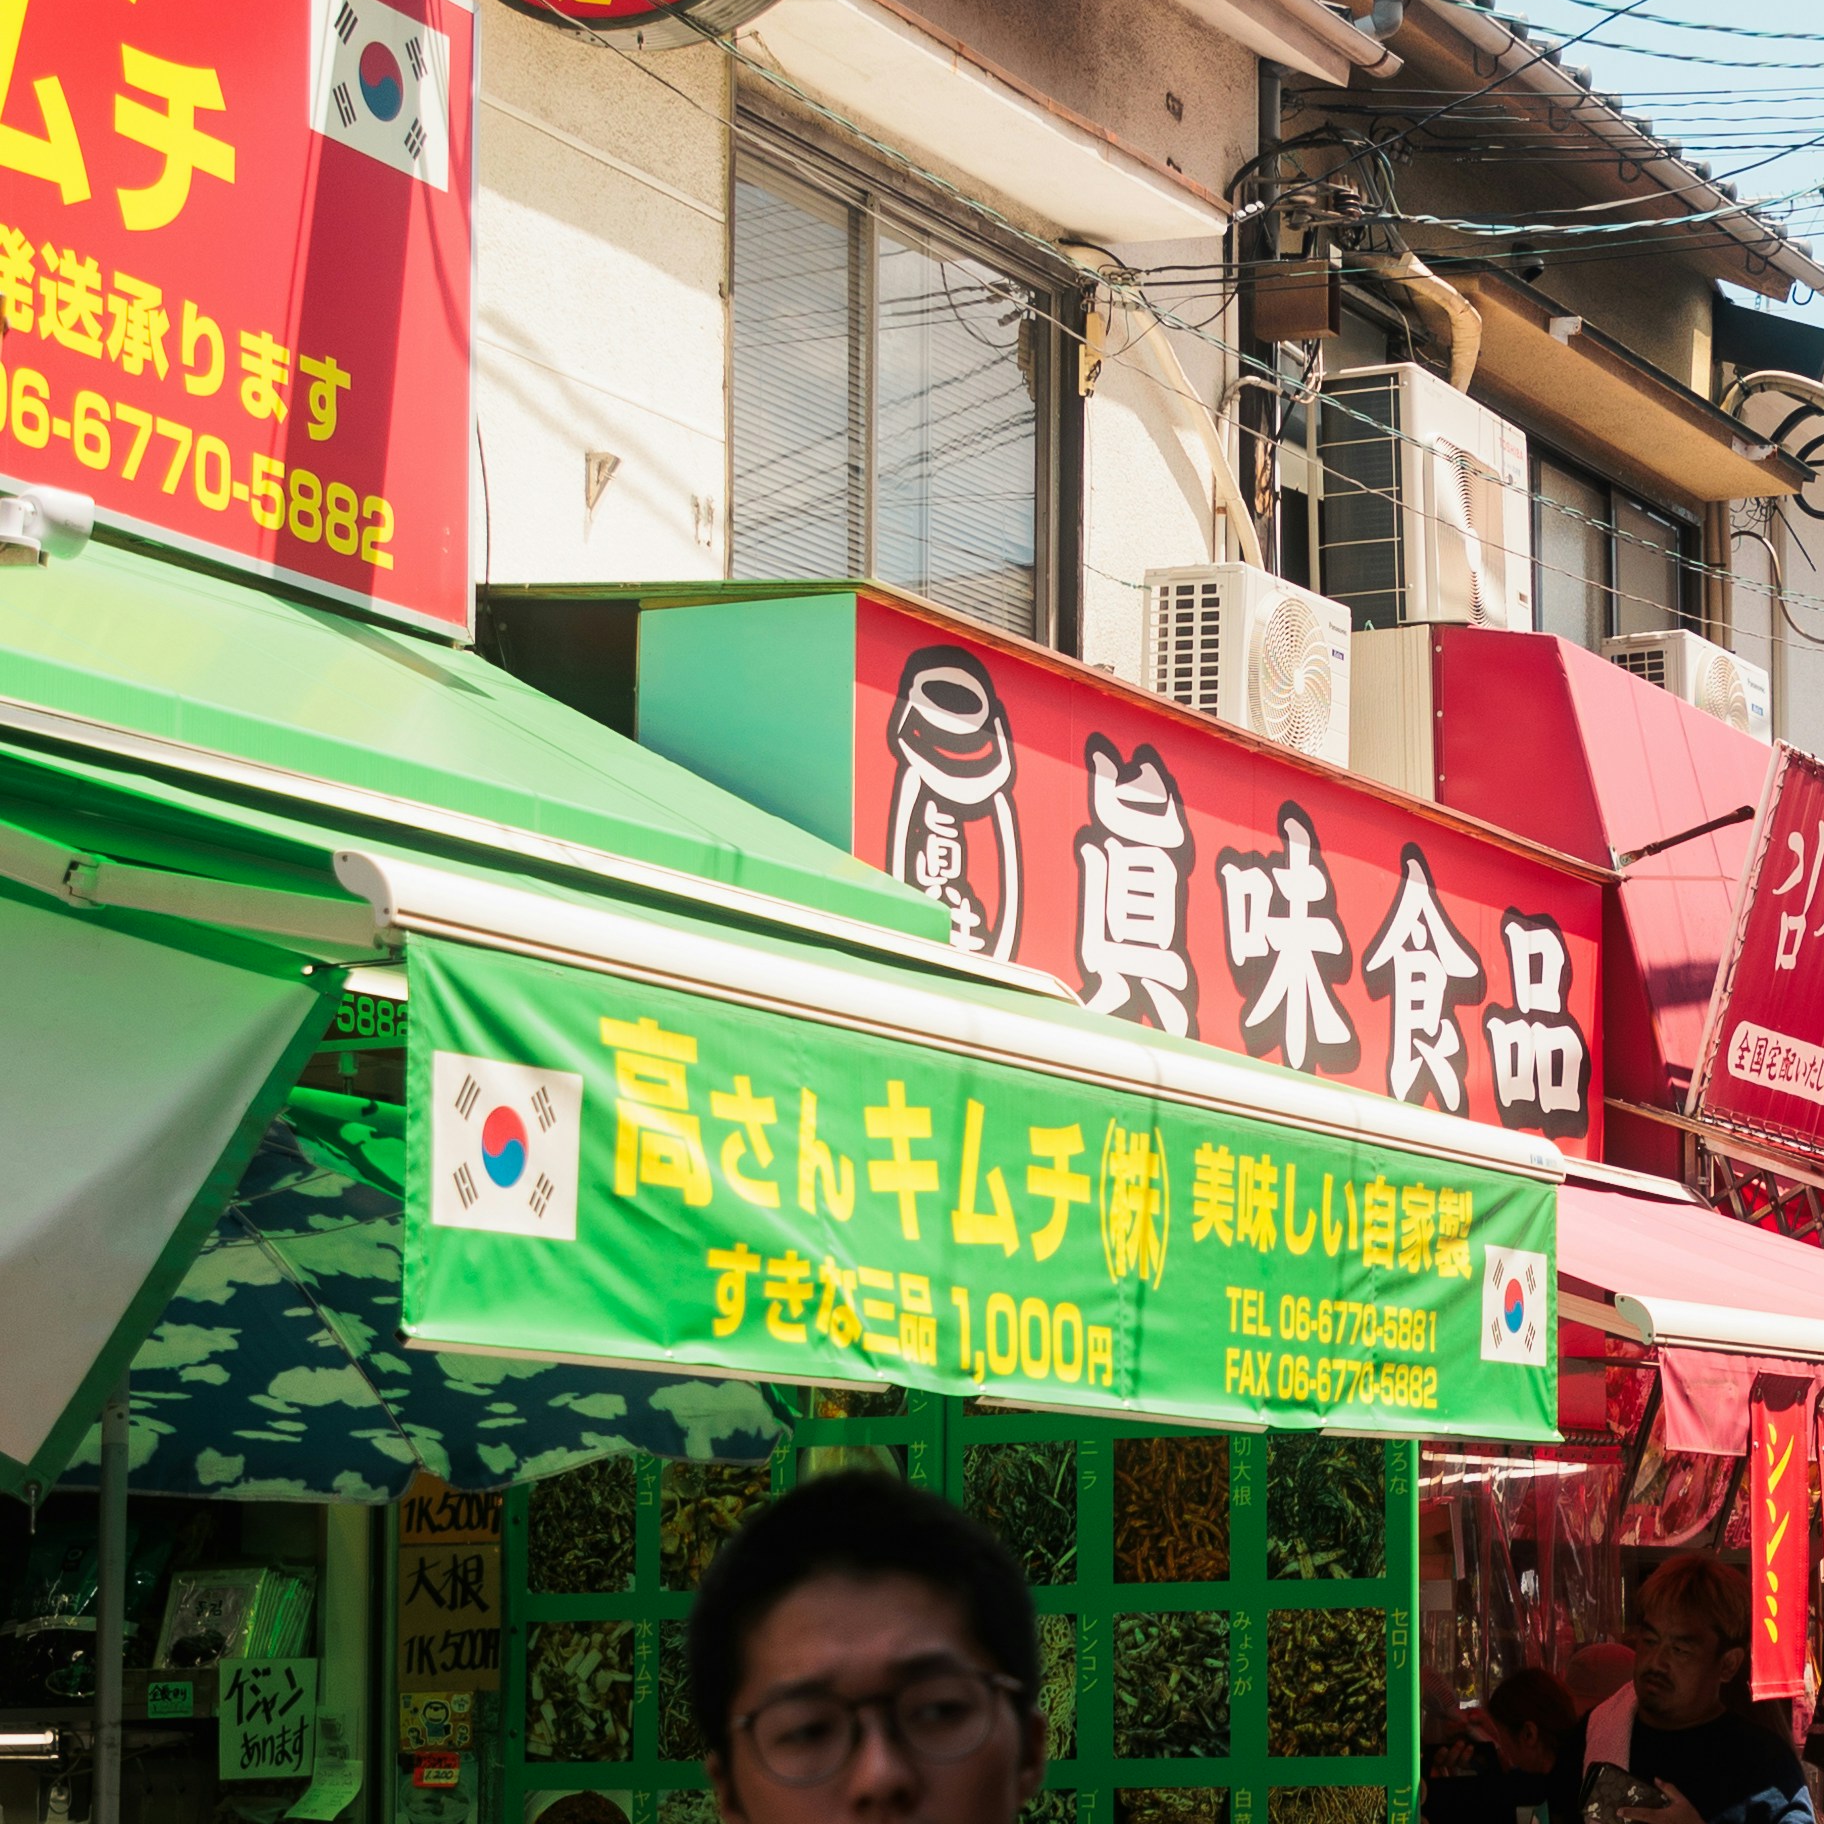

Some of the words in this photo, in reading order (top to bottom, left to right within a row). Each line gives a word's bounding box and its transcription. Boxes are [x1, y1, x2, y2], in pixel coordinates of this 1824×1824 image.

[0, 366, 394, 571] 6-6770-5882
[1192, 1143, 1473, 1280] 美味しい自家製
[707, 1243, 938, 1366] すきな三品
[951, 1286, 1114, 1387] 1,000円
[1226, 1286, 1272, 1338] TEL
[1280, 1294, 1438, 1353] 06-6770-5881
[1226, 1348, 1271, 1398] FAX
[1278, 1356, 1438, 1409] 06-6770-5882
[1079, 1439, 1098, 1491] ニラ
[1232, 1435, 1252, 1507] 切大根
[1766, 1423, 1795, 1646] シンミ
[404, 1554, 491, 1613] 大根
[636, 1619, 653, 1705] 水キムチ
[1080, 1613, 1099, 1694] レンコン
[1232, 1611, 1253, 1698] みょうが
[1389, 1610, 1410, 1670] セロリ
[240, 1716, 309, 1772] あります
